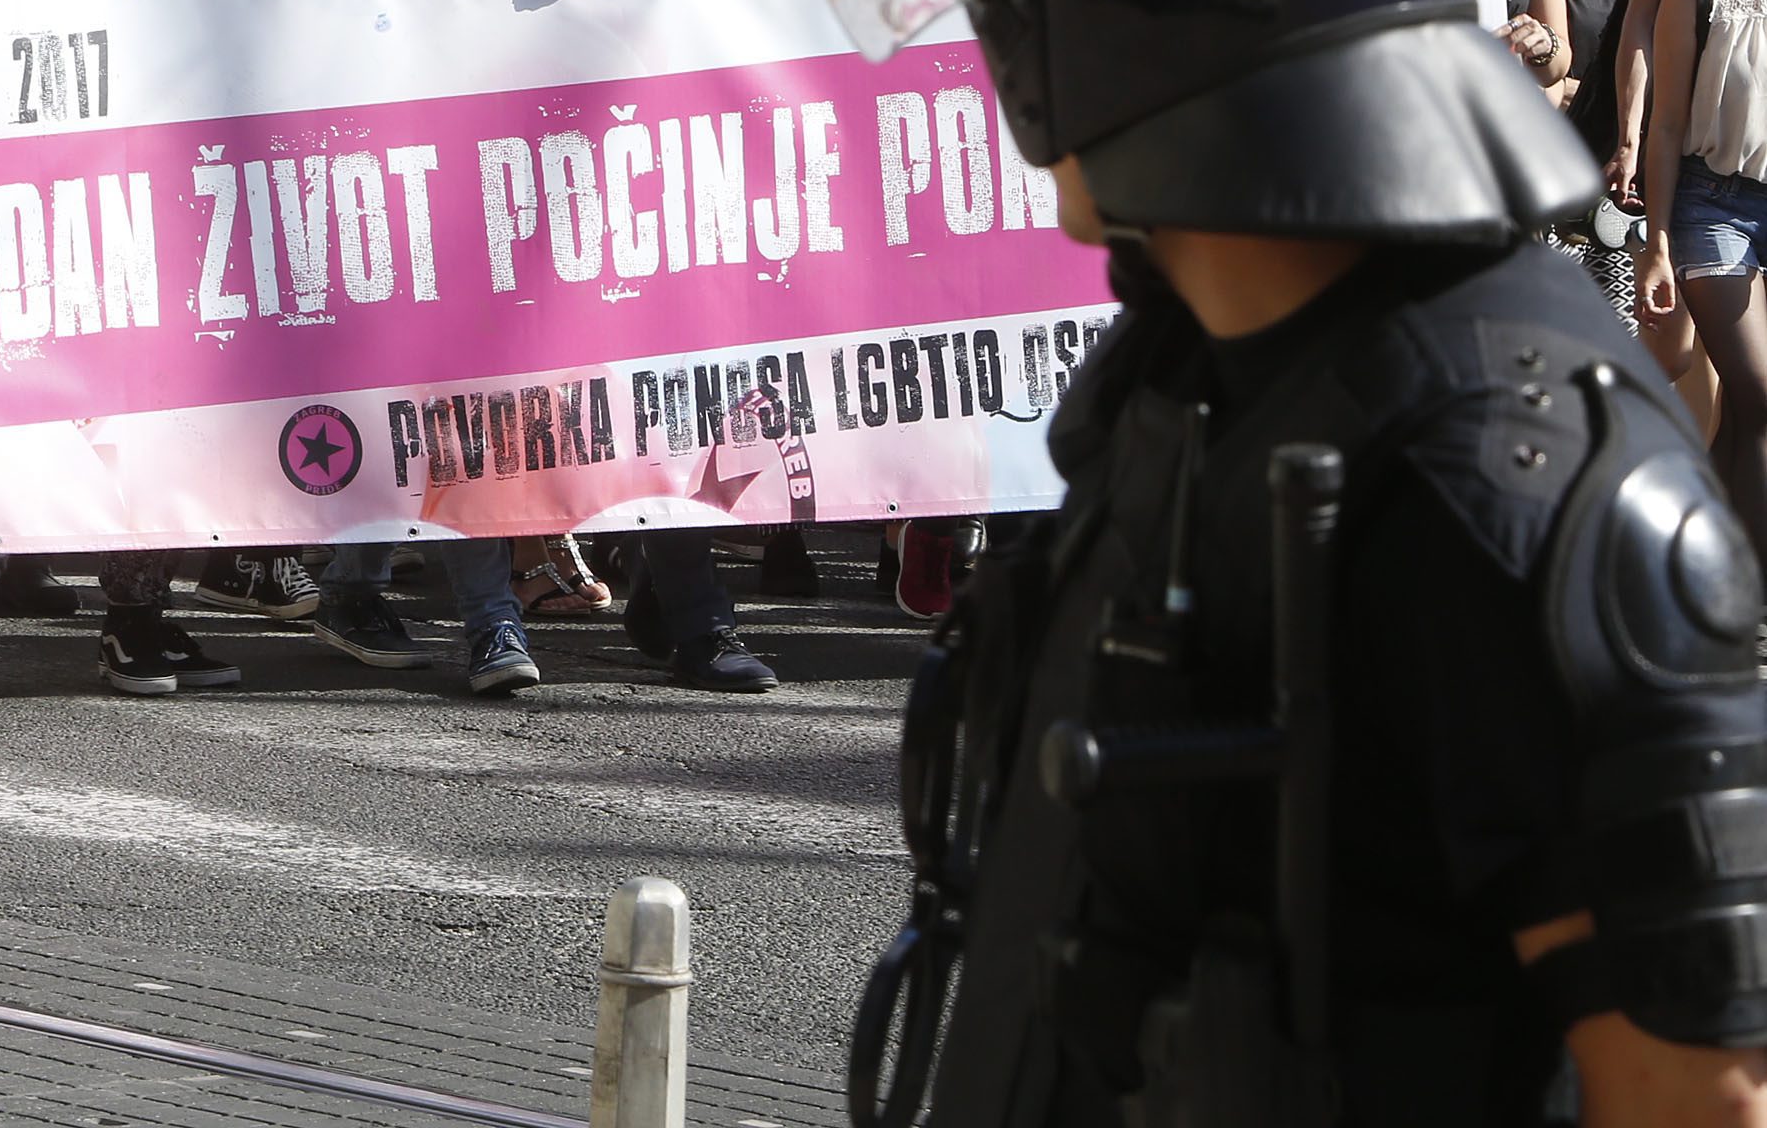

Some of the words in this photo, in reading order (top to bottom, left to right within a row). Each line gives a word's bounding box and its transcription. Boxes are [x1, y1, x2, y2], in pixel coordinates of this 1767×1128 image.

[10, 29, 110, 124] 2017
[189, 144, 440, 344] ŽIVOT
[477, 103, 844, 300] POČINJE
[293, 406, 342, 422] ZAGREB
[387, 377, 616, 488] POVORKA
[634, 351, 817, 462] PONOSA
[304, 481, 343, 494] PRIDE
